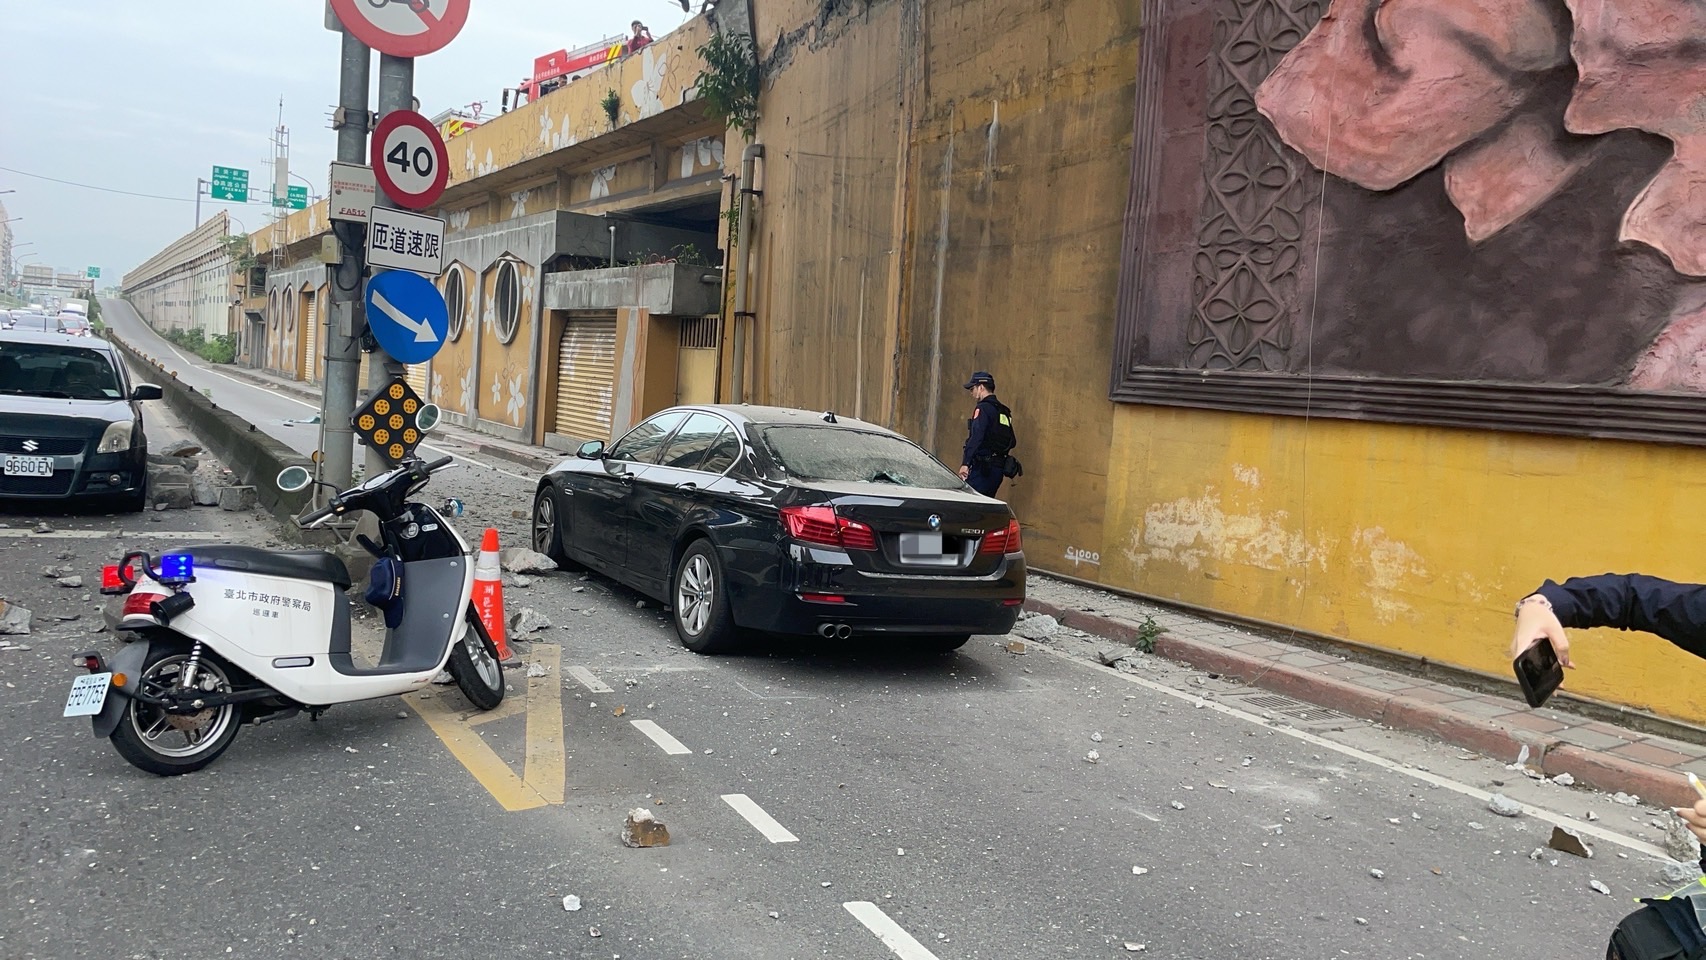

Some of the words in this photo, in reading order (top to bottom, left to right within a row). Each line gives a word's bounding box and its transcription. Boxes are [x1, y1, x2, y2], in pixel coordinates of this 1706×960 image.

[387, 141, 433, 178] 40
[341, 207, 366, 216] EA512
[372, 221, 440, 259] 匝道速限
[223, 588, 312, 612] 臺北市政府警察局
